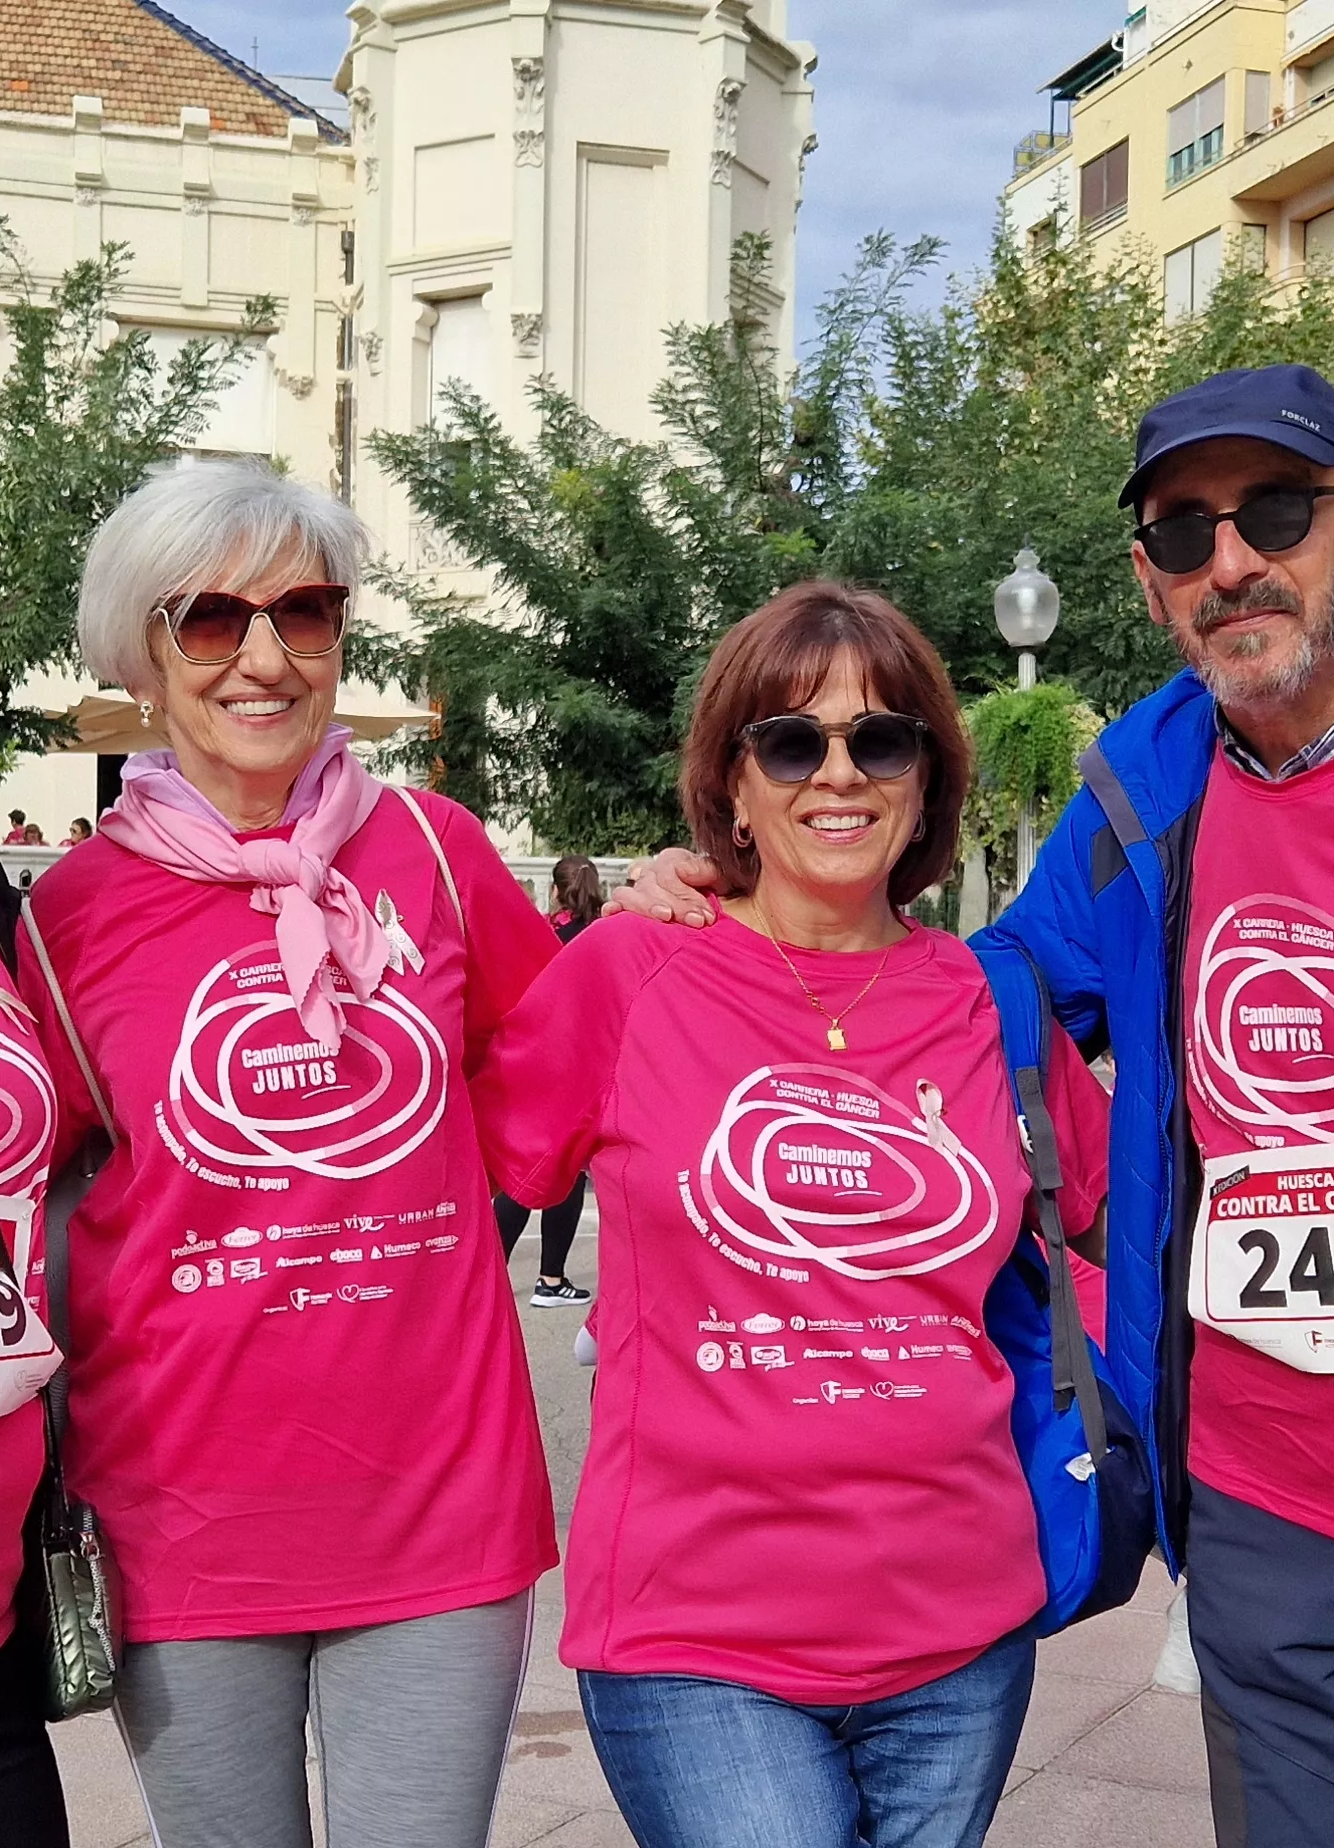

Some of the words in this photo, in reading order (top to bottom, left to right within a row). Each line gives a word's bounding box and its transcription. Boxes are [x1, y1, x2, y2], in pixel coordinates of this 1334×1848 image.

[1281, 409, 1321, 432] FORCLAZ
[1233, 919, 1241, 929] X
[1242, 918, 1285, 930] CARRERA
[1291, 922, 1334, 941] HUESCA
[1239, 929, 1278, 940] CONTRA
[1278, 930, 1290, 942] EL
[229, 971, 238, 981] X
[236, 973, 284, 989] CONTRA
[1239, 1003, 1323, 1025] Caminemos
[1248, 1027, 1323, 1052] JUNTOS
[252, 1061, 337, 1094] JUNTOS
[769, 1079, 778, 1088] X
[836, 1092, 880, 1110] HUESCA
[776, 1089, 819, 1105] CONTRA
[820, 1098, 835, 1109] EL
[778, 1142, 872, 1168] Caminemos
[257, 1177, 290, 1192] apoyo
[786, 1163, 869, 1189] JUNTOS
[1216, 1194, 1293, 1217] CONTRA
[1298, 1192, 1321, 1213] EL
[766, 1262, 778, 1277] Te
[779, 1267, 810, 1283] apoyo
